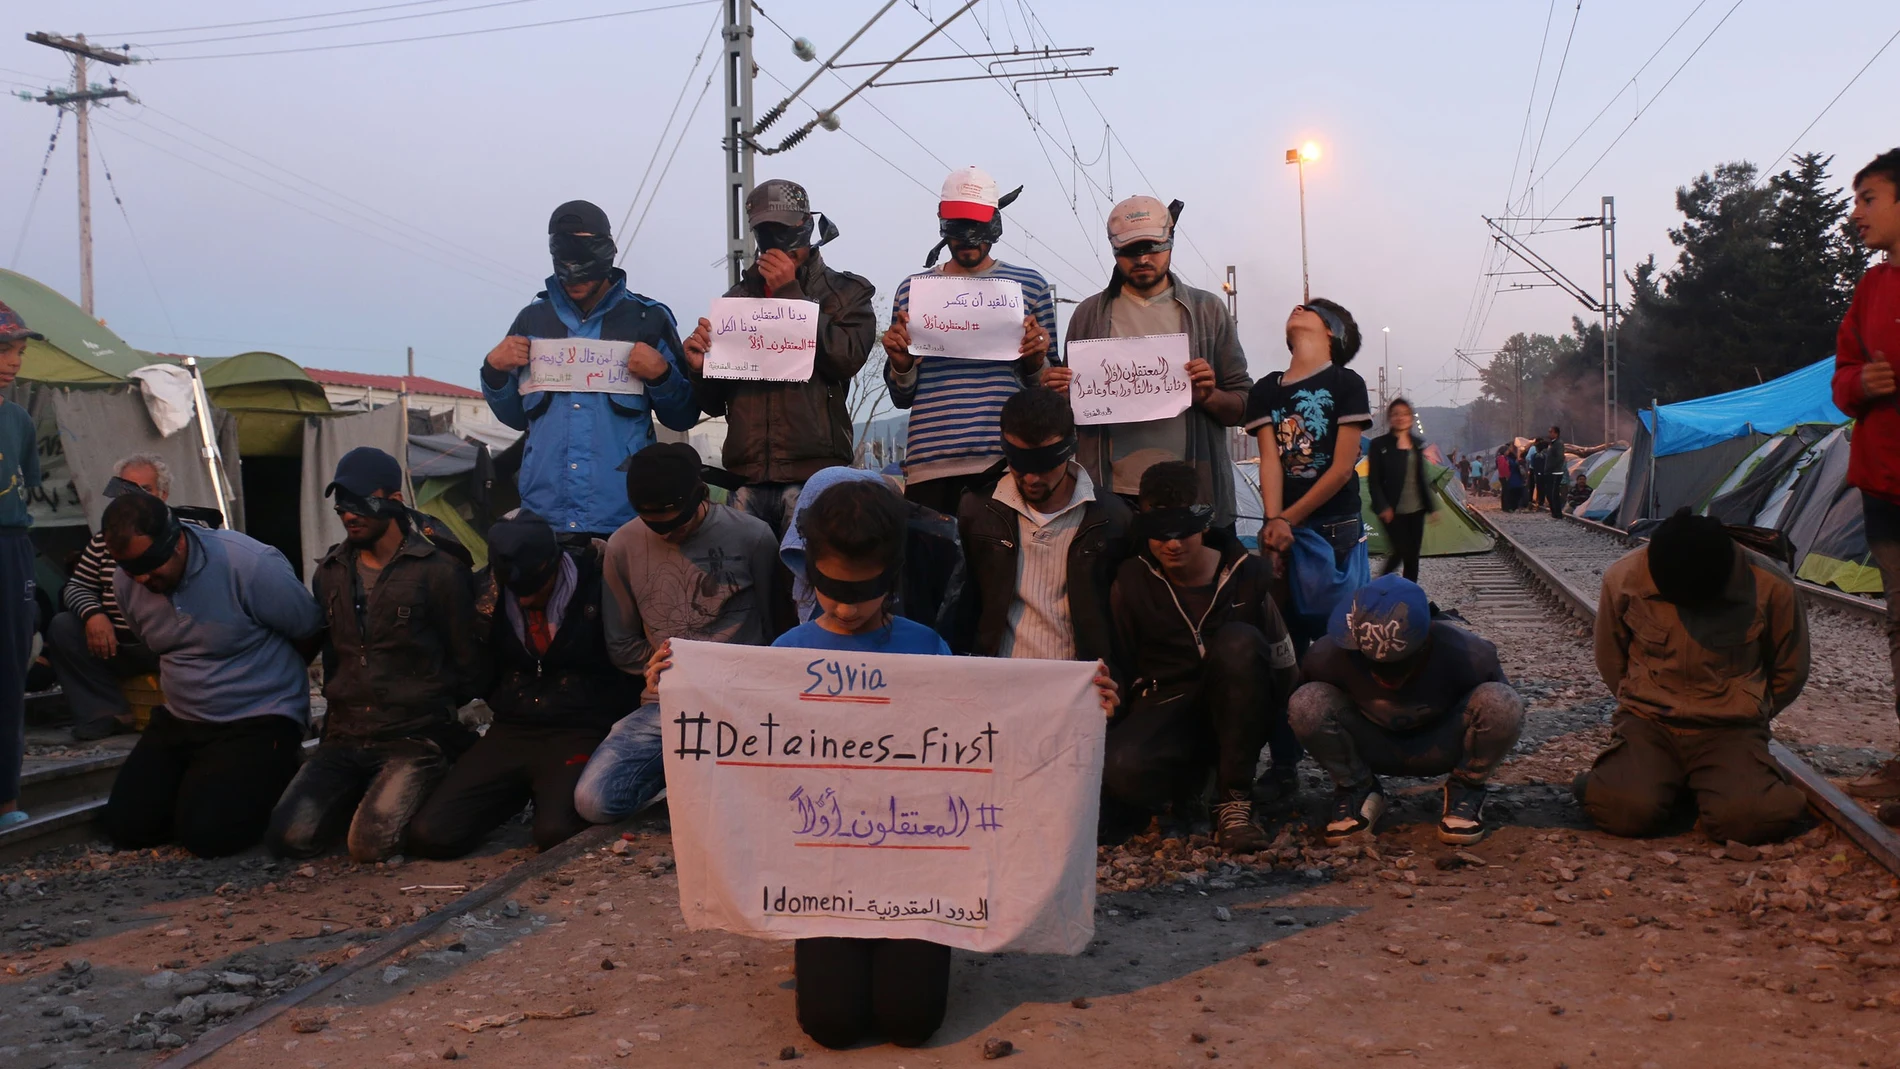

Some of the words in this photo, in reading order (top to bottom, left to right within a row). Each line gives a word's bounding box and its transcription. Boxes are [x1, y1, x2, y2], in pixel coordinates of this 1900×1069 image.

[943, 292, 969, 308] ينكسر
[972, 292, 983, 307] أن
[987, 294, 1007, 309] للقيد
[752, 306, 784, 322] المعتقلين
[788, 305, 807, 322] بدنا
[716, 315, 737, 335] الكل
[740, 318, 757, 335] بدنا
[555, 348, 564, 366] في
[566, 346, 576, 363] لا
[579, 347, 595, 363] قال
[586, 370, 604, 386] نعم
[804, 658, 887, 696] Syria
[945, 897, 989, 921] الحدود
